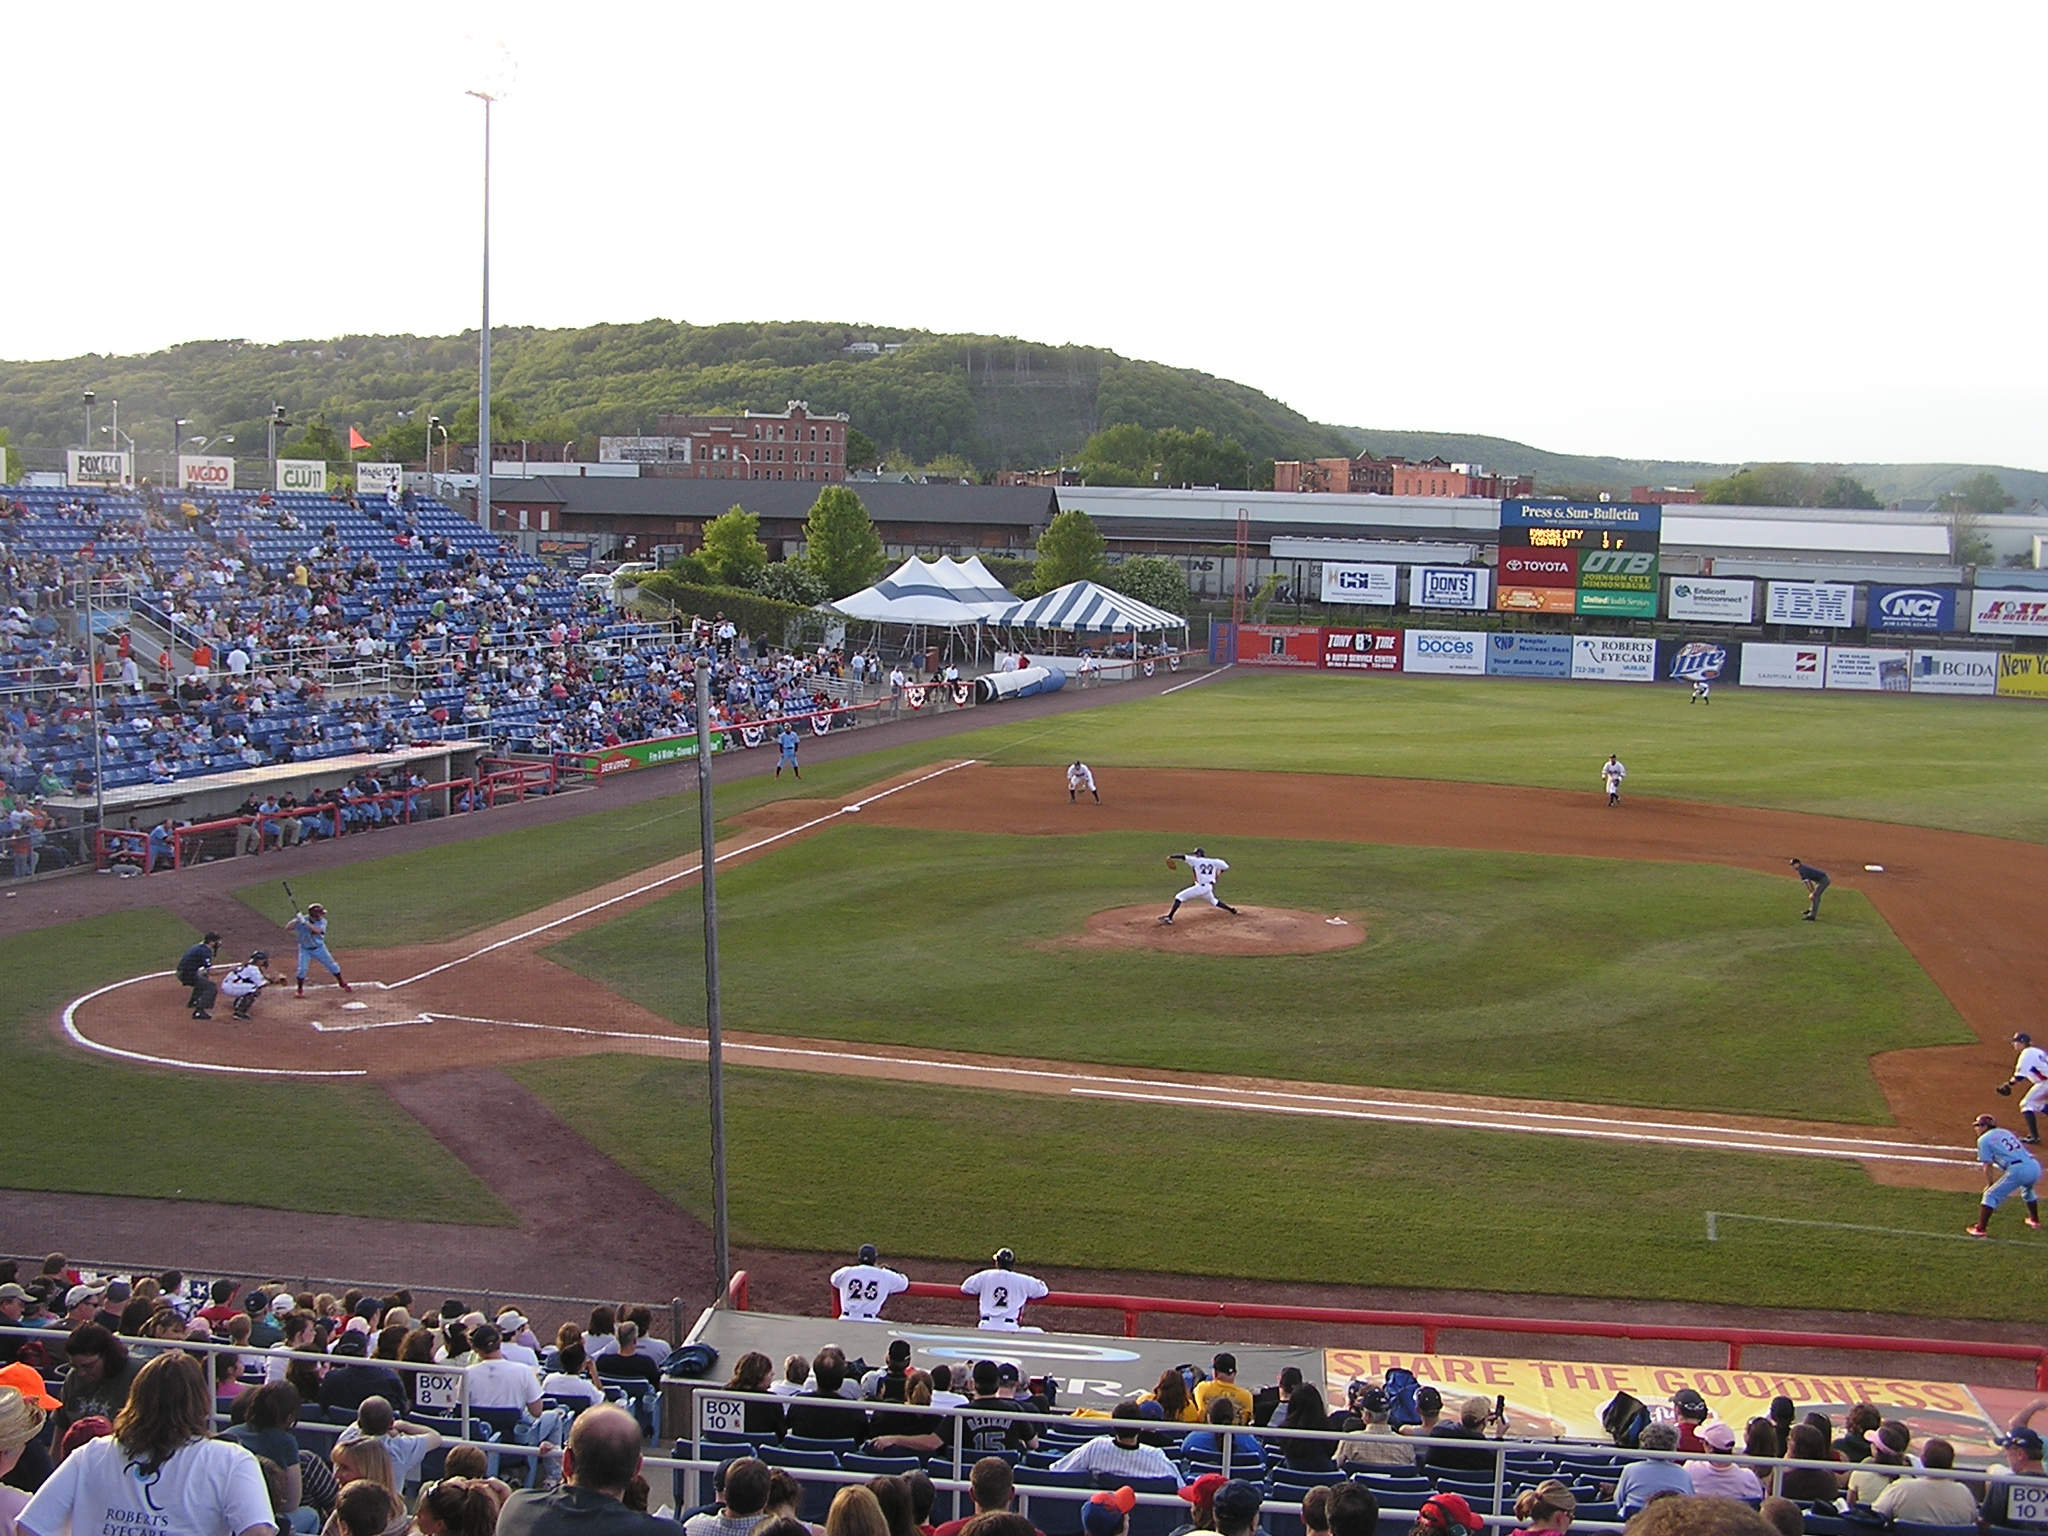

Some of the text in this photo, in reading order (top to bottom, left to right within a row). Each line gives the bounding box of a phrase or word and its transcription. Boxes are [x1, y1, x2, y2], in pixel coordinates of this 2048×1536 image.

[78, 455, 121, 473] FOX 40
[186, 465, 229, 482] WCDO
[360, 466, 382, 480] Magic
[1521, 504, 1639, 521] Press & Sun-Bulletin
[1562, 529, 1584, 540] CITY
[1523, 560, 1569, 573] TOYOTA
[1581, 551, 1655, 574] OTB
[1431, 575, 1468, 592] DON'S
[1582, 580, 1651, 590] NIMMONSBURG
[1583, 573, 1651, 584] JOHNSON CITY
[1693, 586, 1726, 596] Endicott
[1693, 594, 1742, 604] Interconnect
[1583, 595, 1609, 605] United
[1773, 588, 1848, 621] IBM
[1892, 599, 1942, 617] NCI
[1978, 612, 2000, 620] TIRE
[1327, 634, 1352, 649] TONY
[1375, 636, 1395, 650] TIRE
[1418, 635, 1474, 654] boces
[1494, 635, 1515, 651] PNB
[1519, 637, 1547, 646] Peoples
[1601, 640, 1653, 652] ROBERTS
[1332, 653, 1348, 662] AUTO
[1601, 652, 1651, 664] EYECARE
[1671, 650, 1726, 677] Lite
[1942, 661, 1994, 677] BCIDA
[2000, 654, 2032, 678] New
[848, 1278, 878, 1300] 25
[993, 1286, 1008, 1307] 2
[420, 1375, 453, 1391] BOX
[1333, 1351, 1964, 1412] SHARE THE GOODNESS
[421, 1390, 432, 1404] 8
[706, 1400, 741, 1416] BOX
[708, 1415, 727, 1429] 10
[973, 1431, 1006, 1452] 15
[105, 1508, 169, 1527] ROBERTS
[2016, 1503, 2036, 1518] 10
